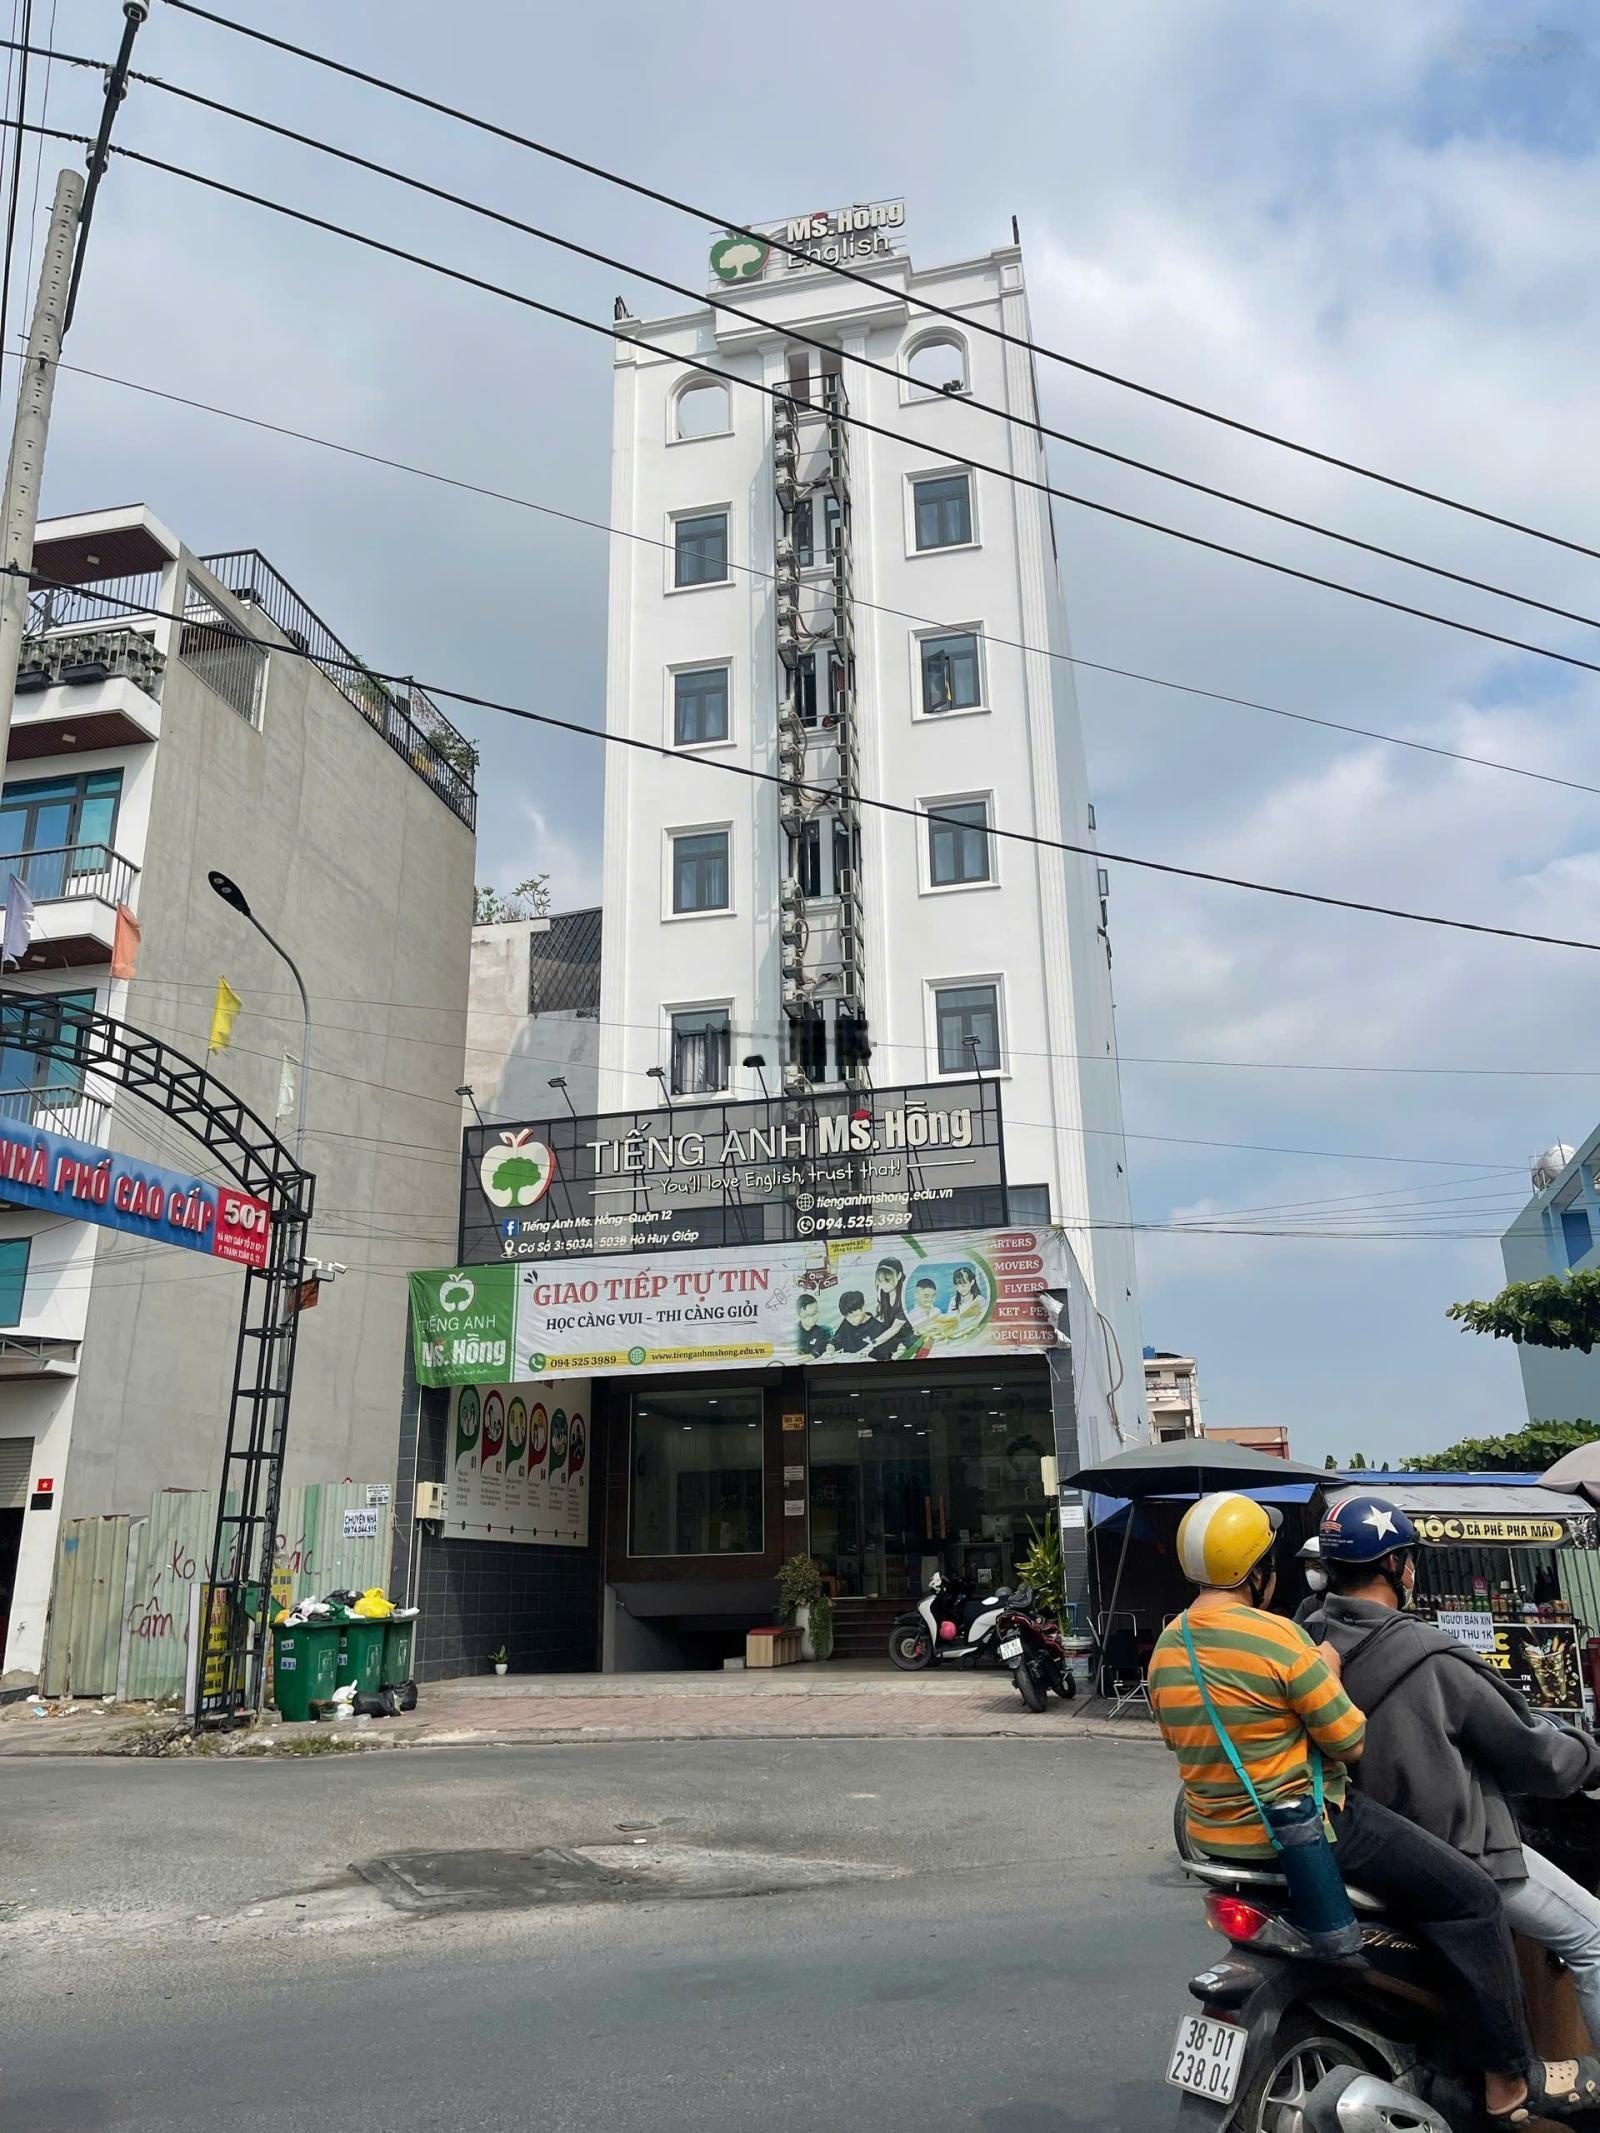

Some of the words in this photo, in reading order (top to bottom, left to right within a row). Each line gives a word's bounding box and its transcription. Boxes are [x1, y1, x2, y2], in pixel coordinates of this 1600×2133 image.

[786, 216, 835, 244] Ms.
[787, 233, 889, 269] English
[586, 1122, 706, 1174] TIẾNG
[719, 1123, 807, 1163] ANH
[818, 1112, 880, 1155] Ms.
[659, 1174, 701, 1194] You'll
[708, 1173, 741, 1191] love
[745, 1165, 805, 1193] English,
[808, 1163, 854, 1183] trust
[860, 1158, 901, 1180] that!
[54, 1157, 113, 1204] PHỐ
[115, 1175, 165, 1221] CAO
[168, 1187, 215, 1233] CẤP
[816, 1188, 954, 1210] tienganhmshong.edu.vn
[224, 1199, 267, 1234] 501
[551, 1217, 574, 1230] Anh
[574, 1215, 593, 1228] Ms.
[661, 1209, 673, 1221] 12
[816, 1212, 913, 1231] 094.525.3989
[518, 1242, 535, 1253] Cơ
[536, 1238, 551, 1252] Sở
[629, 1232, 645, 1245] Hà
[647, 1232, 669, 1246] Huy
[671, 1229, 700, 1243] Giáp
[995, 1259, 1040, 1271] MOVERS
[533, 1280, 598, 1307] GIAO
[604, 1266, 668, 1301] TIẾP
[673, 1268, 714, 1302] TỰ
[719, 1268, 770, 1292] TIN
[1004, 1282, 1045, 1294] FLYERS
[463, 1314, 496, 1331] ANH
[546, 1316, 576, 1333] HỌC
[577, 1311, 616, 1329] CÀNG
[617, 1312, 643, 1325] VUI
[656, 1309, 682, 1322] THI
[684, 1303, 725, 1321] CÀNG
[727, 1300, 759, 1318] GIỎI
[998, 1307, 1020, 1318] KET
[550, 1358, 571, 1368] 094
[572, 1356, 590, 1367] 525
[591, 1355, 617, 1366] 3989
[651, 1347, 766, 1361] www.tienganhmshong.edu.vn
[1466, 1520, 1481, 1536] CÀ
[1484, 1522, 1504, 1537] PHÊ
[1507, 1524, 1528, 1537] PHA
[1530, 1522, 1555, 1538] MÁY
[1480, 1615, 1492, 1626] XIN
[1462, 1630, 1480, 1640] THU
[1482, 1629, 1493, 1640] 1K
[1185, 2020, 1236, 2061] 38-D1
[1171, 2050, 1231, 2097] 238.04
